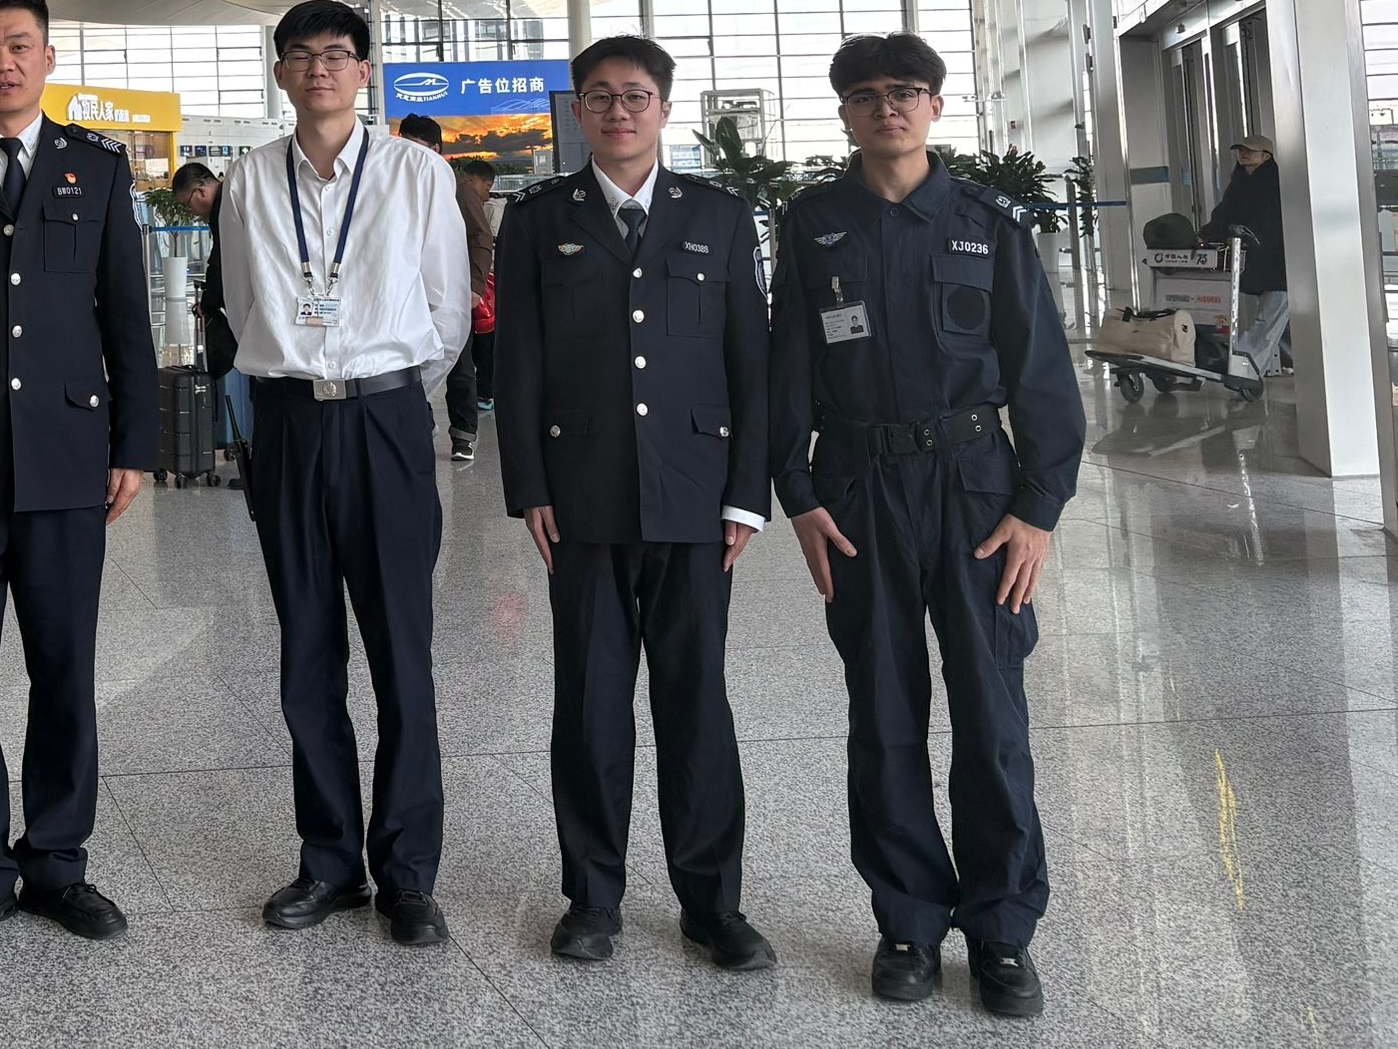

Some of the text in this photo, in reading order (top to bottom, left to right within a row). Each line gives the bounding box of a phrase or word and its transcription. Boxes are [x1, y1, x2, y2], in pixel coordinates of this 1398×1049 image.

[460, 77, 544, 94] 广告位招商
[951, 240, 989, 255] XJ0236
